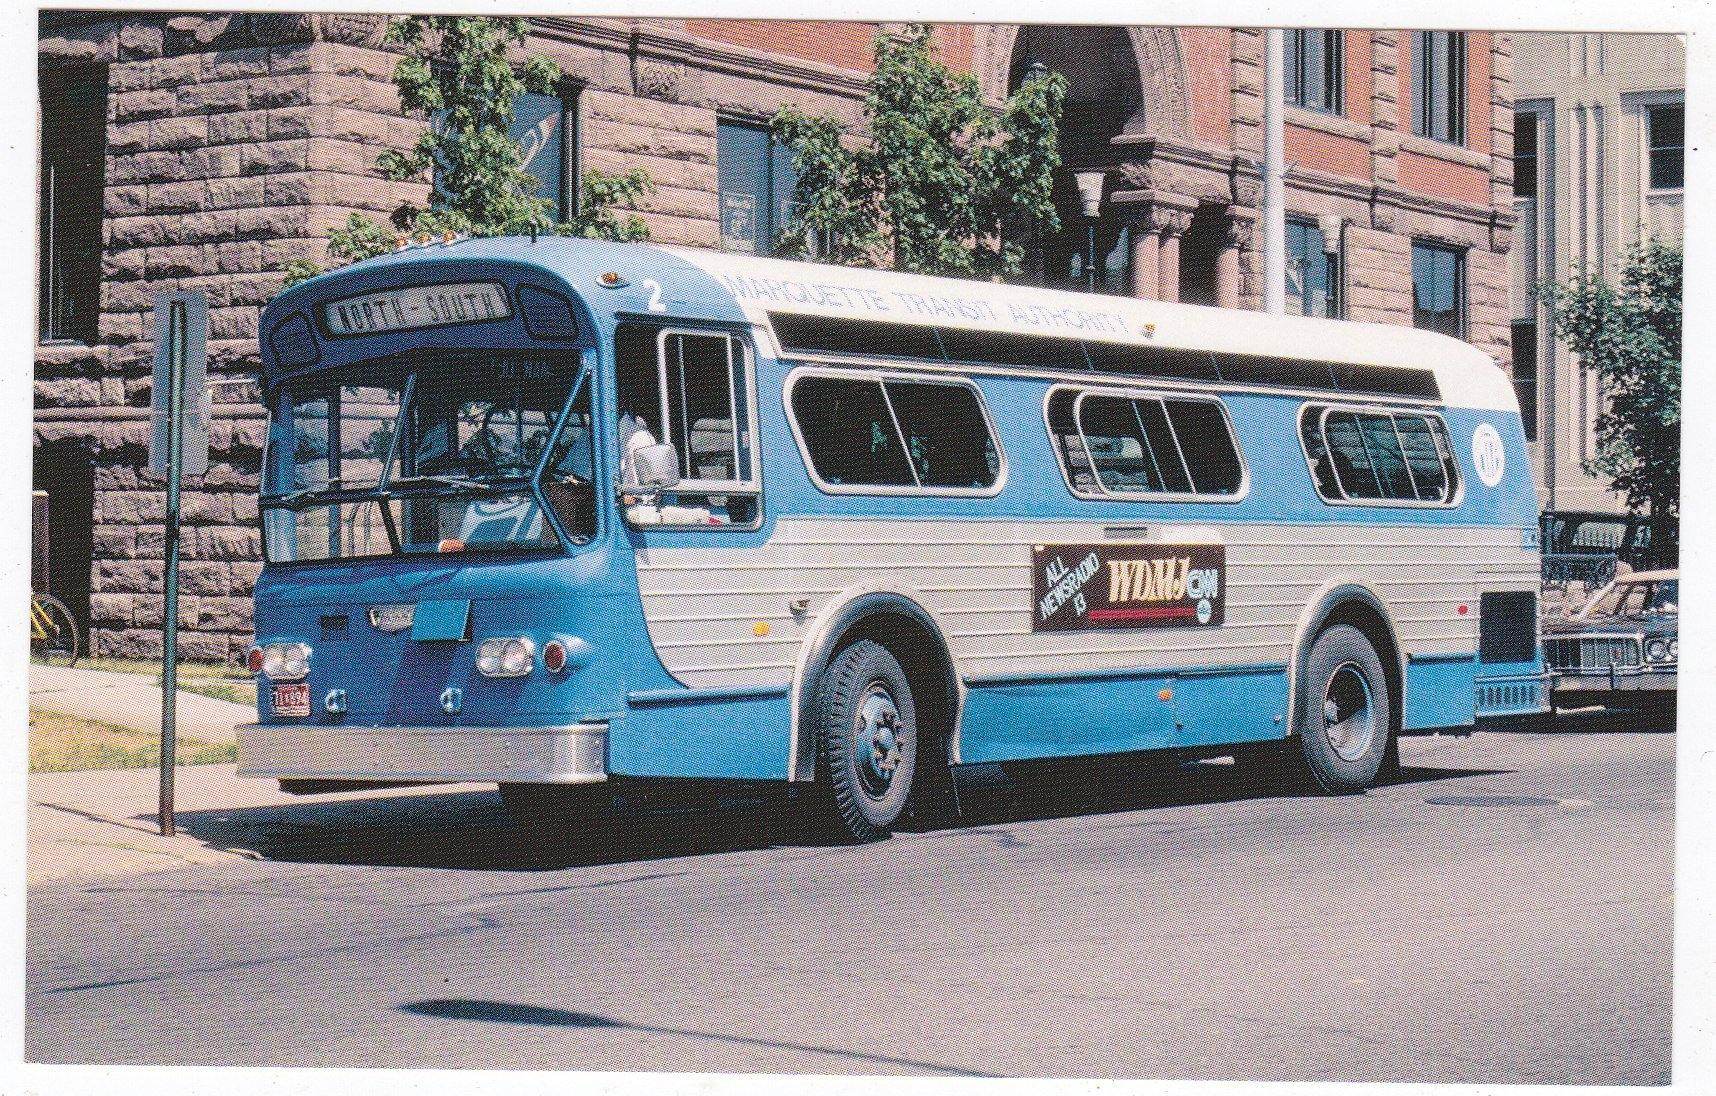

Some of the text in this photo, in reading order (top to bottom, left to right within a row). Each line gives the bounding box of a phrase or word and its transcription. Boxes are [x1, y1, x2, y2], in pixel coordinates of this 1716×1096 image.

[643, 279, 666, 312] 2
[724, 273, 1130, 335] MARQUETTE TRANSIT AUTHORITY
[1039, 552, 1100, 620] NEWSRADIO
[1045, 556, 1069, 588] ALL
[1106, 557, 1190, 602] WDMJ
[1187, 568, 1218, 599] CNN
[1073, 592, 1087, 616] 13
